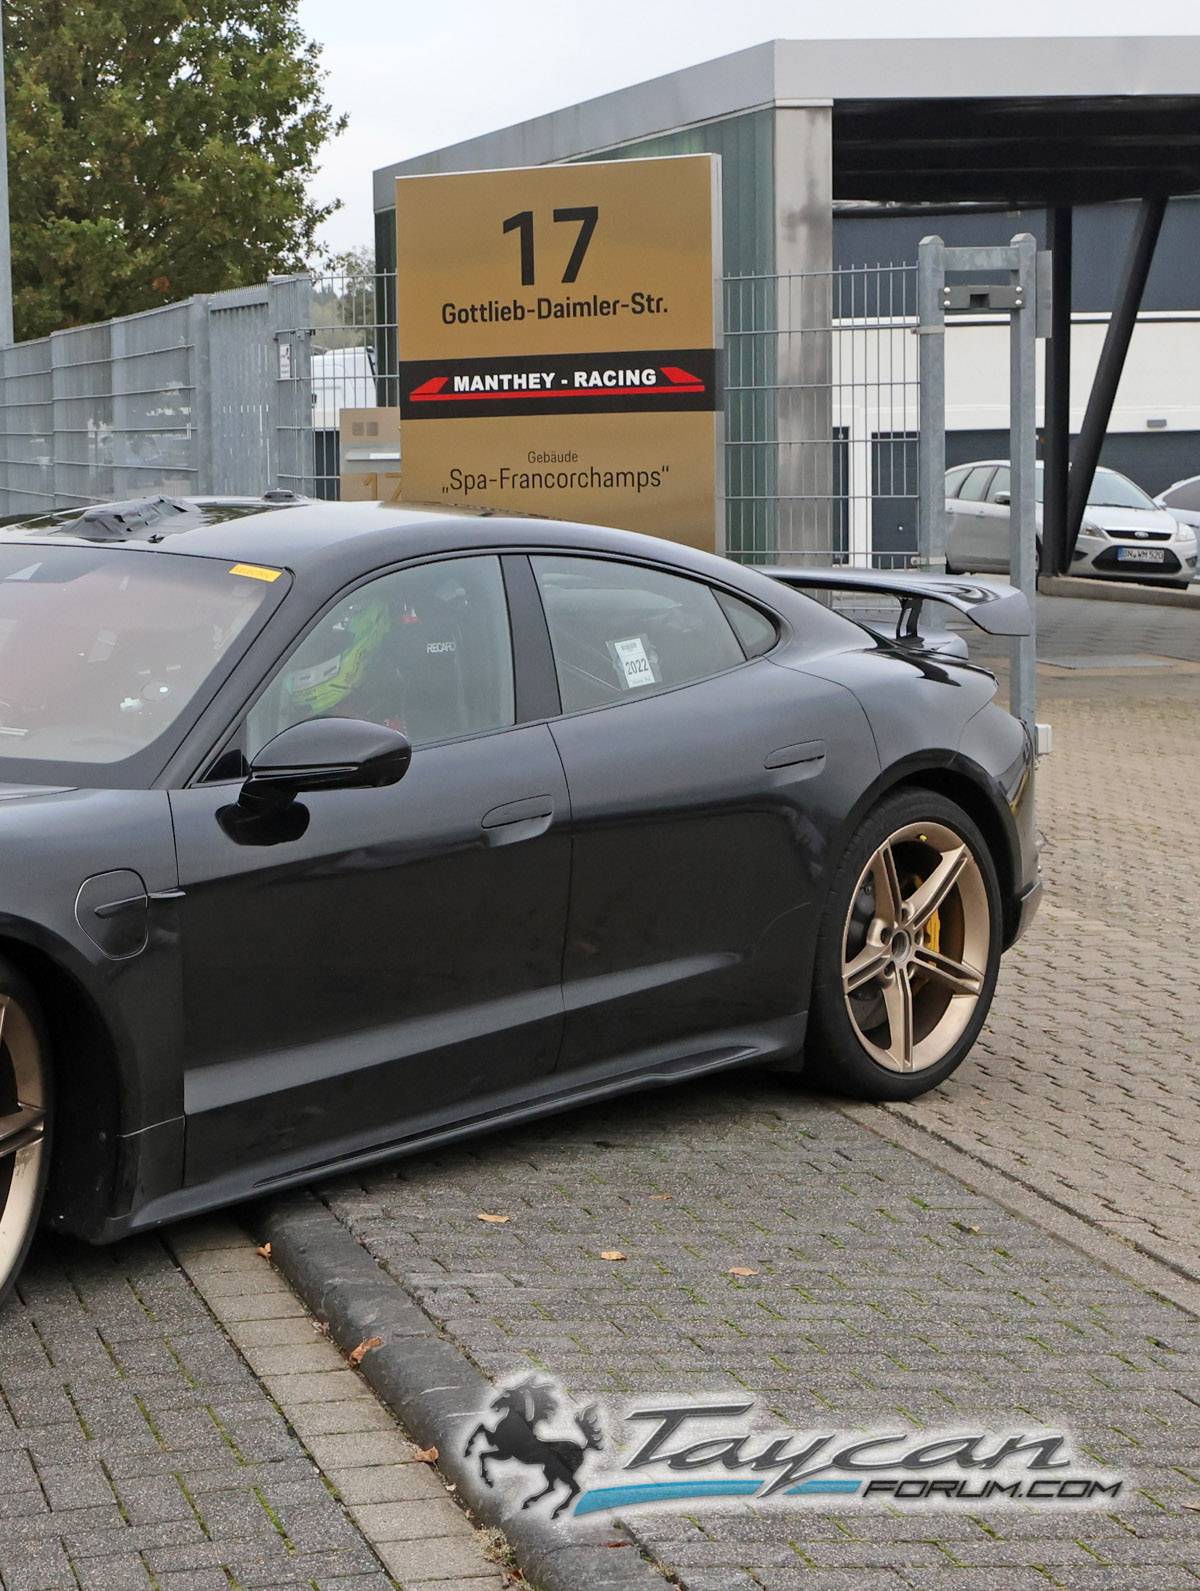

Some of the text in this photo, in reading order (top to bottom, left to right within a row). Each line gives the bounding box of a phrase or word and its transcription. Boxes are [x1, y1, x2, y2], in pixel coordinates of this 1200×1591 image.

[502, 206, 599, 286] 17
[441, 291, 669, 326] Gottlieb-Daimler-Str.
[453, 372, 556, 392] MANTHEY
[573, 368, 657, 388] RACING
[527, 450, 579, 464] Gebäude
[625, 658, 649, 675] 2022
